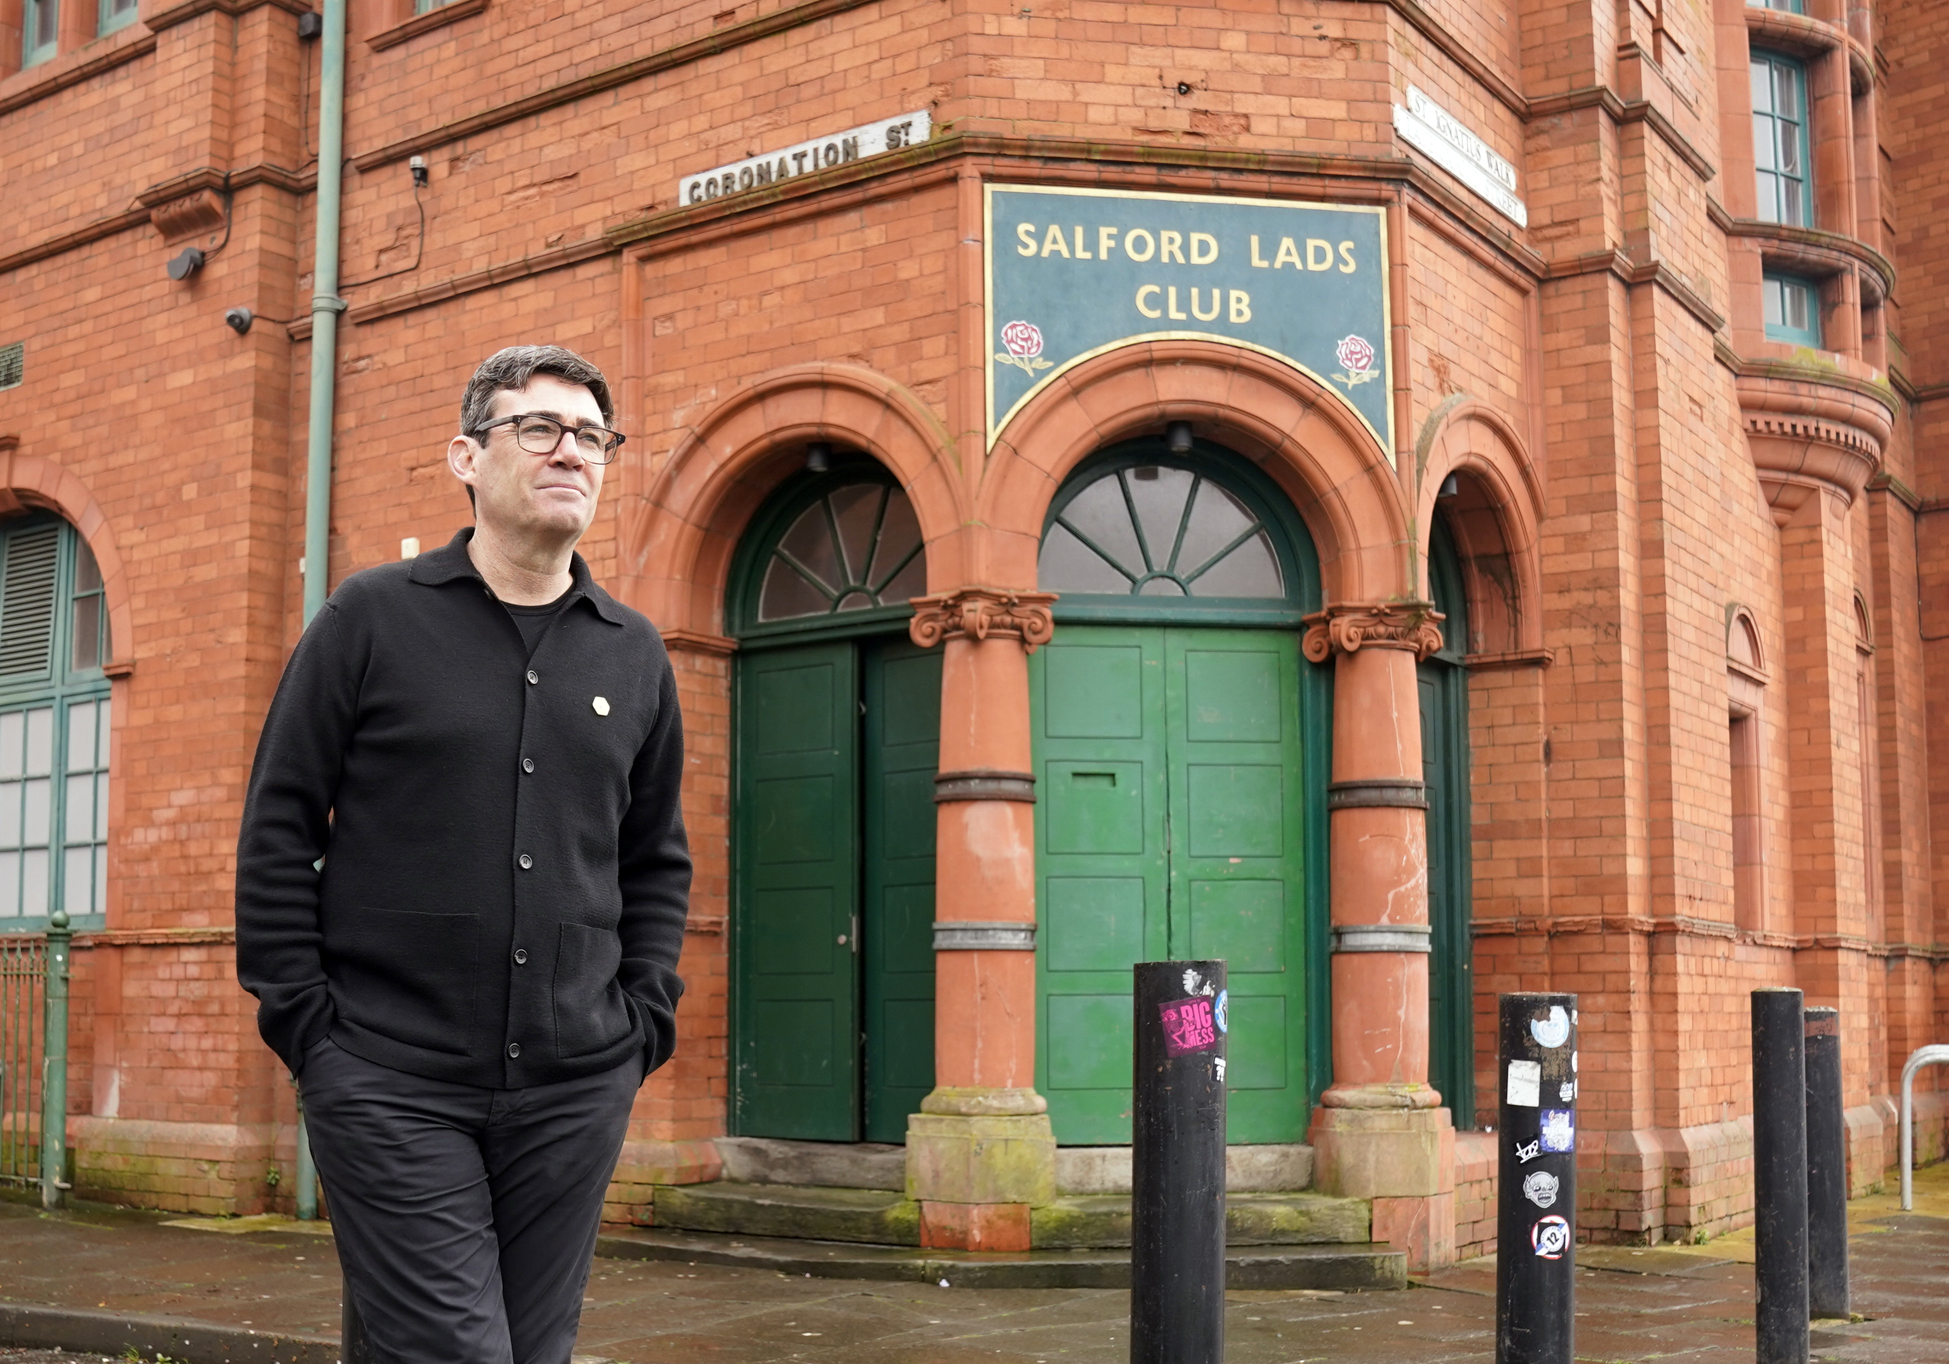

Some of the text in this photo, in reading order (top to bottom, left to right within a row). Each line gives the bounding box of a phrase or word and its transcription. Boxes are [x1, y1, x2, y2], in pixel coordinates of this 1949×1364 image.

[689, 136, 859, 204] CORONATION
[1435, 110, 1482, 161] IGNATIUS
[1485, 149, 1512, 187] WALK
[1016, 222, 1357, 274] SALFORD LADS
[1135, 284, 1252, 324] CLUB
